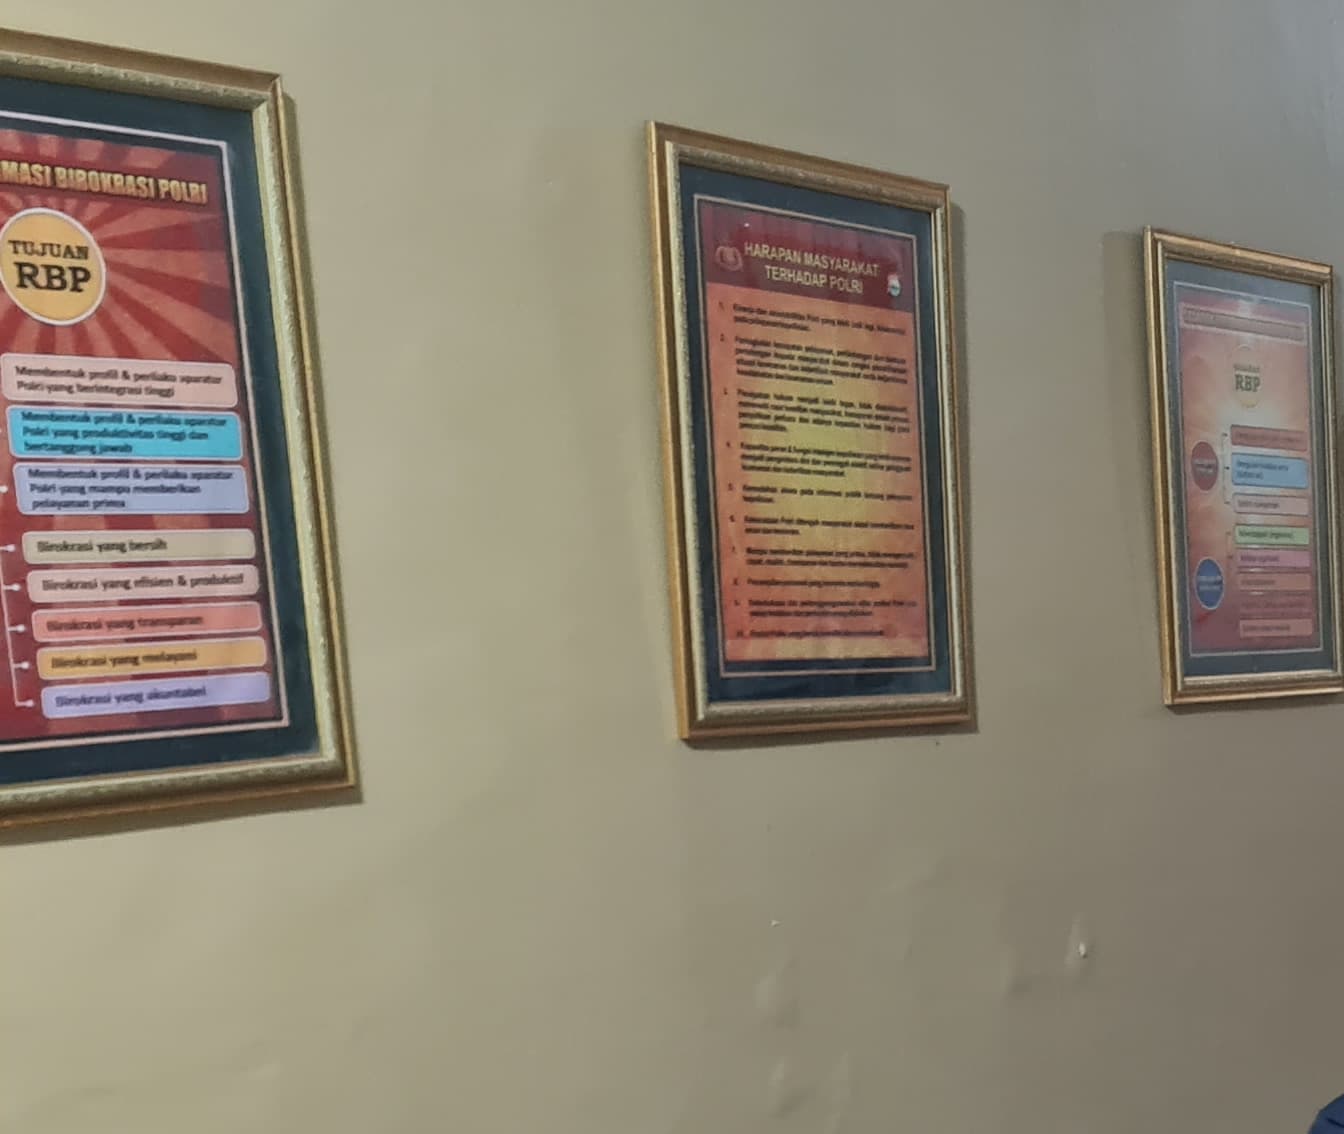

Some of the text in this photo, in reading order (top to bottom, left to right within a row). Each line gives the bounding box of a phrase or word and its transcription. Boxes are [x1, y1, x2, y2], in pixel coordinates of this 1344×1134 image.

[0, 161, 208, 203] MASI BIROKRASI POLRI
[8, 240, 89, 260] TUJUAN
[745, 242, 879, 277] HARAPAN MASYARAKAT
[14, 262, 91, 293] RBP
[765, 265, 863, 294] TERHADAP POLRI
[15, 366, 85, 378] Membentuk
[122, 371, 130, 380] &
[126, 414, 135, 424] &
[133, 470, 141, 479] &
[101, 579, 131, 590] yang
[177, 575, 187, 586] &
